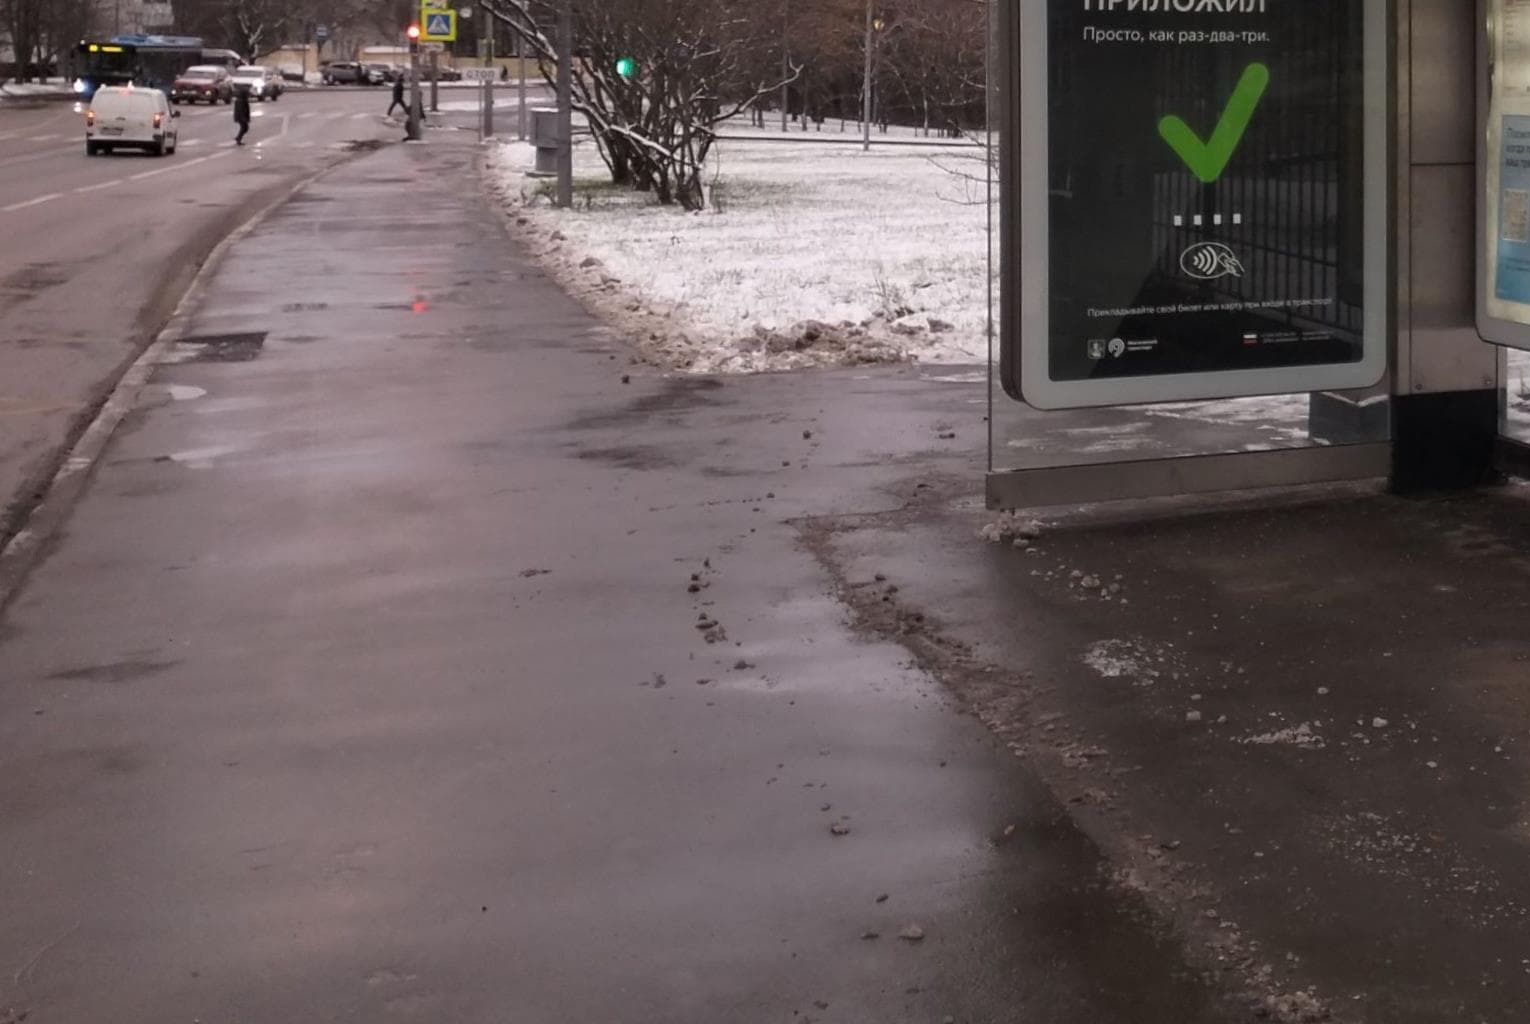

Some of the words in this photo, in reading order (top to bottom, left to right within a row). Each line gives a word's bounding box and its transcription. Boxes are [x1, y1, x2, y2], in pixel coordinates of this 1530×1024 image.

[1083, 26, 1145, 44] Просто,
[1149, 29, 1174, 42] как
[1178, 29, 1270, 45] раз-два-три.
